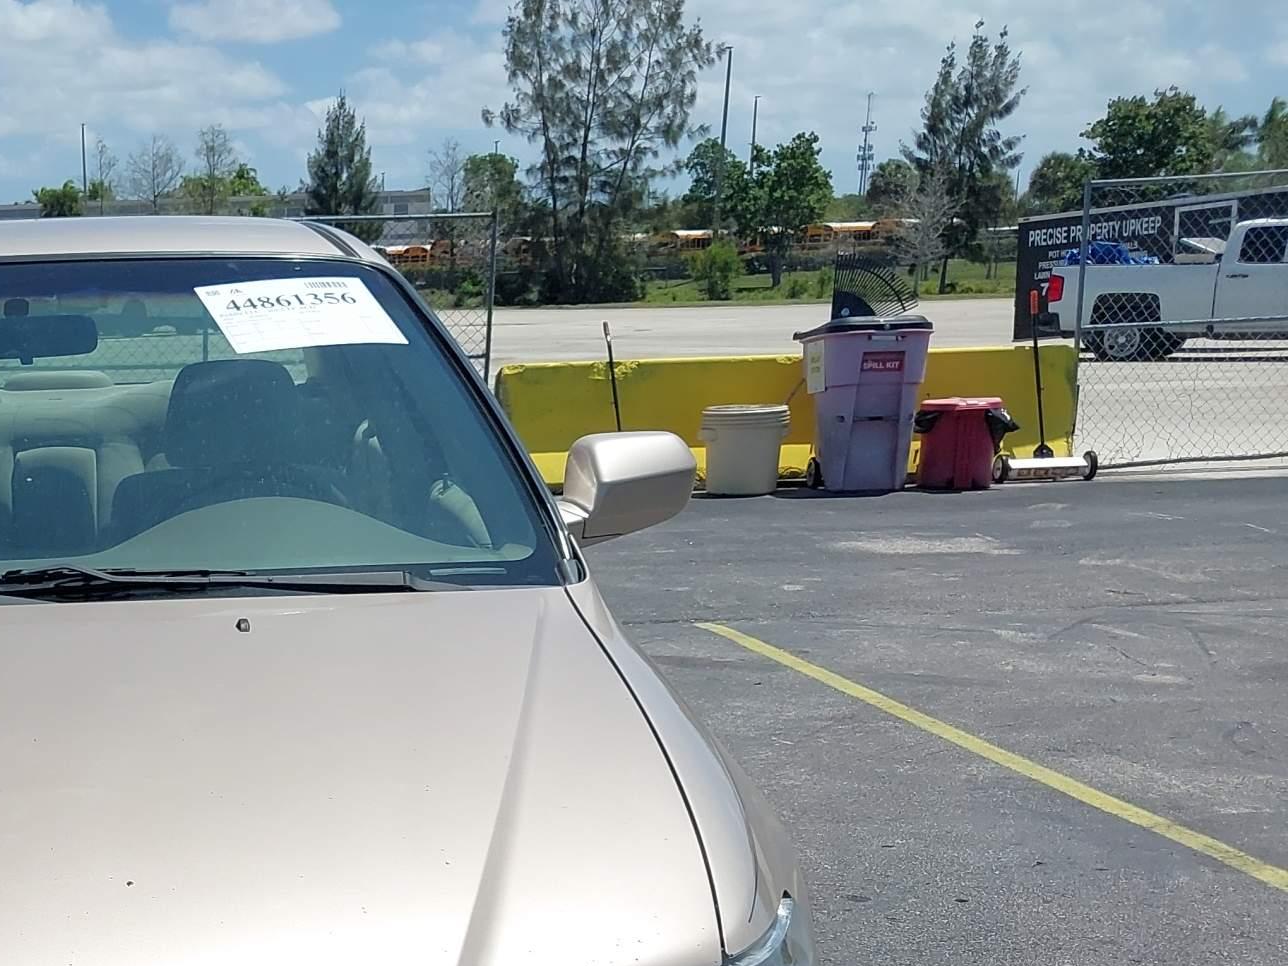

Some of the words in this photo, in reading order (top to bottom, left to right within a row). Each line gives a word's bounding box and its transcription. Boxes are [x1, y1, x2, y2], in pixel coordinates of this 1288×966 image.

[1028, 227, 1068, 247] PRECISE
[1070, 221, 1120, 242] PRPERTY
[1122, 216, 1162, 236] UPKEEP
[226, 292, 357, 312] 44861356
[863, 361, 884, 370] SPILL
[886, 361, 900, 369] KIT
